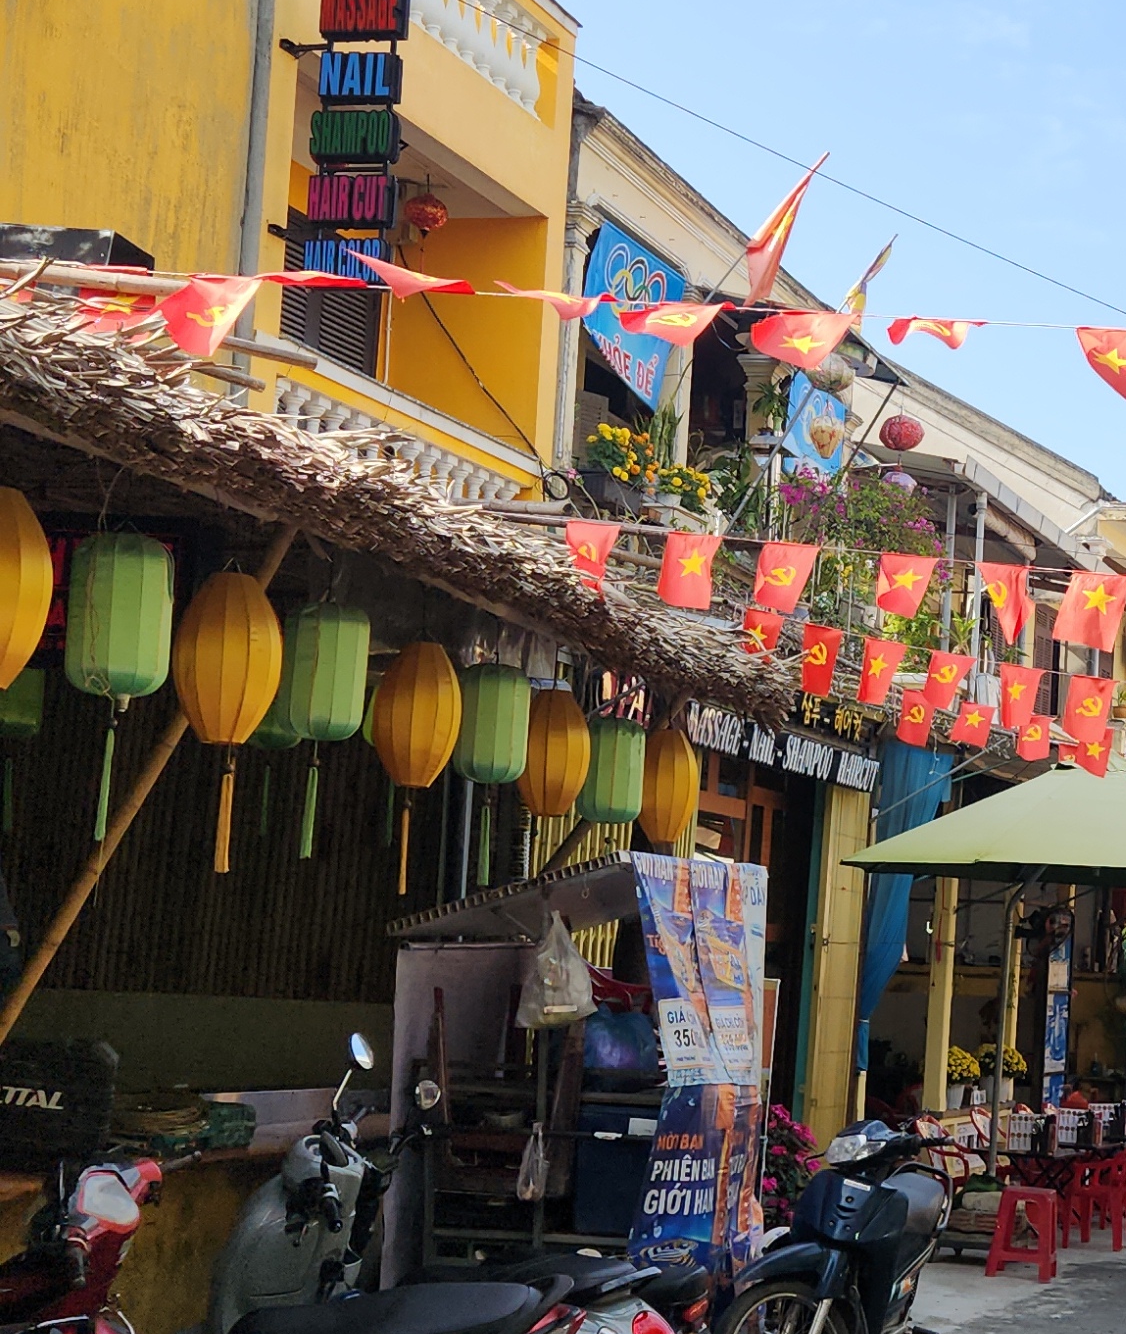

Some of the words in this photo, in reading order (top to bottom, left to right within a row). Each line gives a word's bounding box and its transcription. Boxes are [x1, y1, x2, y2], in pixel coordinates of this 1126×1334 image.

[319, 53, 389, 96] NAIL
[310, 111, 390, 155] SHAMPOO
[308, 176, 349, 221] HAIR
[352, 175, 387, 220] CUT
[304, 240, 335, 274] HAIR
[338, 238, 381, 282] COLOR
[686, 702, 745, 757] MASSAGE
[749, 723, 775, 766] NAIL
[782, 734, 834, 780] SHAMPOO
[836, 751, 880, 792] HAIRCUT
[667, 1005, 686, 1024] GIÁ
[650, 1154, 701, 1182] PHIÊN
[643, 1183, 692, 1216] GIỚI
